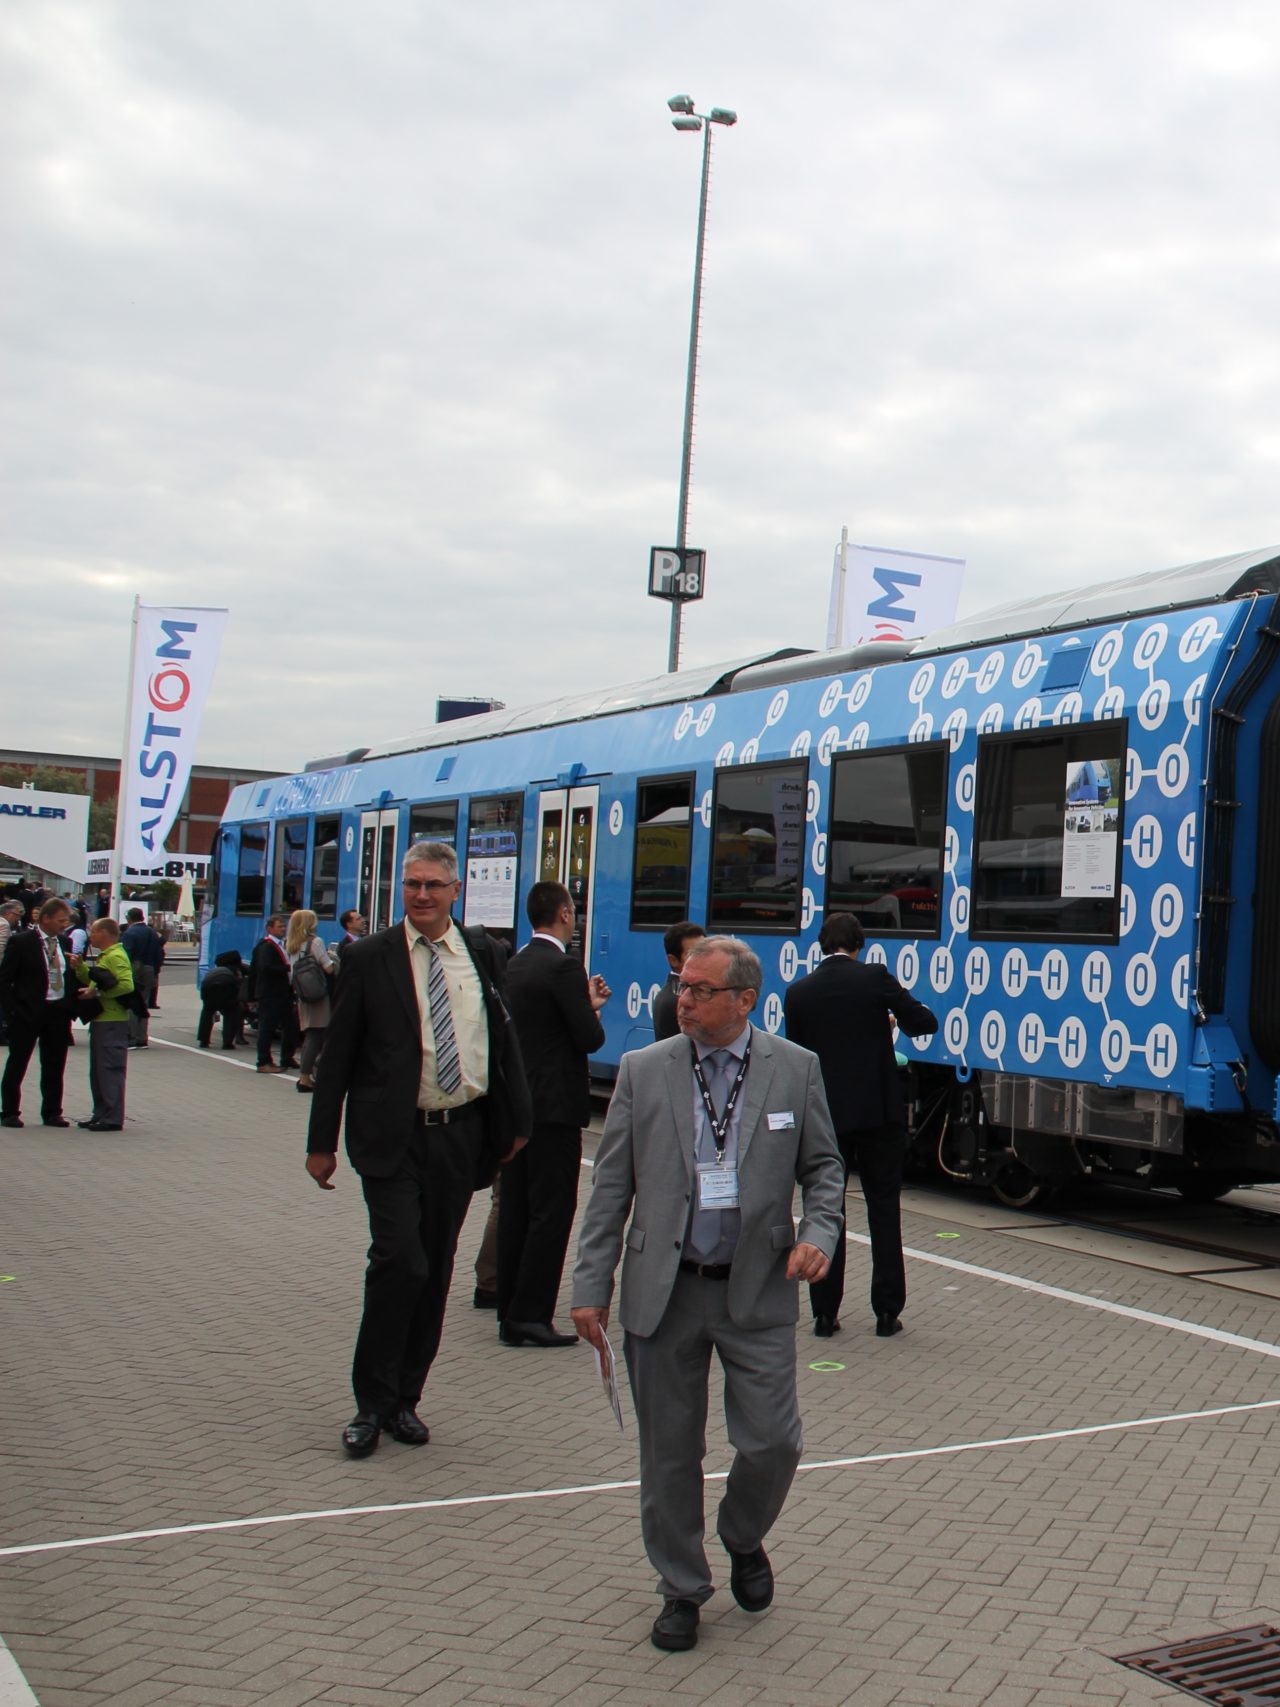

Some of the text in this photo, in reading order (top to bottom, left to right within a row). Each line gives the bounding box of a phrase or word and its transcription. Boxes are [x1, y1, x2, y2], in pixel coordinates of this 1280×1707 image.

[652, 551, 699, 594] P 18
[1141, 631, 1160, 660] O
[1186, 625, 1210, 654] H
[1019, 653, 1035, 679] O
[1098, 639, 1115, 667] O
[915, 671, 929, 695] O
[946, 665, 964, 691] H
[981, 658, 999, 686] H
[824, 687, 837, 711] H
[855, 682, 868, 700] O
[772, 698, 783, 718] O
[1021, 706, 1036, 729] H
[1060, 701, 1077, 724] H
[1102, 695, 1118, 719] H
[1146, 689, 1162, 720] O
[679, 713, 690, 731] O
[702, 711, 711, 729] H
[915, 721, 927, 742] O
[948, 717, 962, 743] H
[983, 711, 998, 734] H
[139, 619, 197, 852] ALSTOM
[796, 740, 807, 757] H
[824, 734, 836, 759] H
[853, 729, 866, 749] H
[720, 750, 731, 766] H
[745, 745, 754, 763] O
[1166, 754, 1180, 787] O
[807, 788, 815, 813] O
[962, 773, 973, 802] O
[0, 803, 67, 820] ADLER
[613, 809, 619, 827] 2
[818, 842, 827, 866] O
[1140, 827, 1154, 856] H
[957, 895, 967, 924] O
[1160, 894, 1174, 927] O
[784, 949, 794, 975] H
[903, 954, 912, 981] O
[936, 958, 946, 981] H
[971, 958, 983, 984] H
[1009, 960, 1021, 986] H
[1048, 960, 1060, 989] H
[1090, 962, 1103, 992] H
[1134, 963, 1147, 996] O
[630, 988, 638, 1010] H
[768, 1001, 778, 1026] H
[951, 1017, 961, 1045] O
[987, 1020, 998, 1049] O
[1025, 1025, 1038, 1053] H
[1066, 1027, 1079, 1056] H
[1109, 1030, 1122, 1062] O
[1154, 1035, 1168, 1066] H
